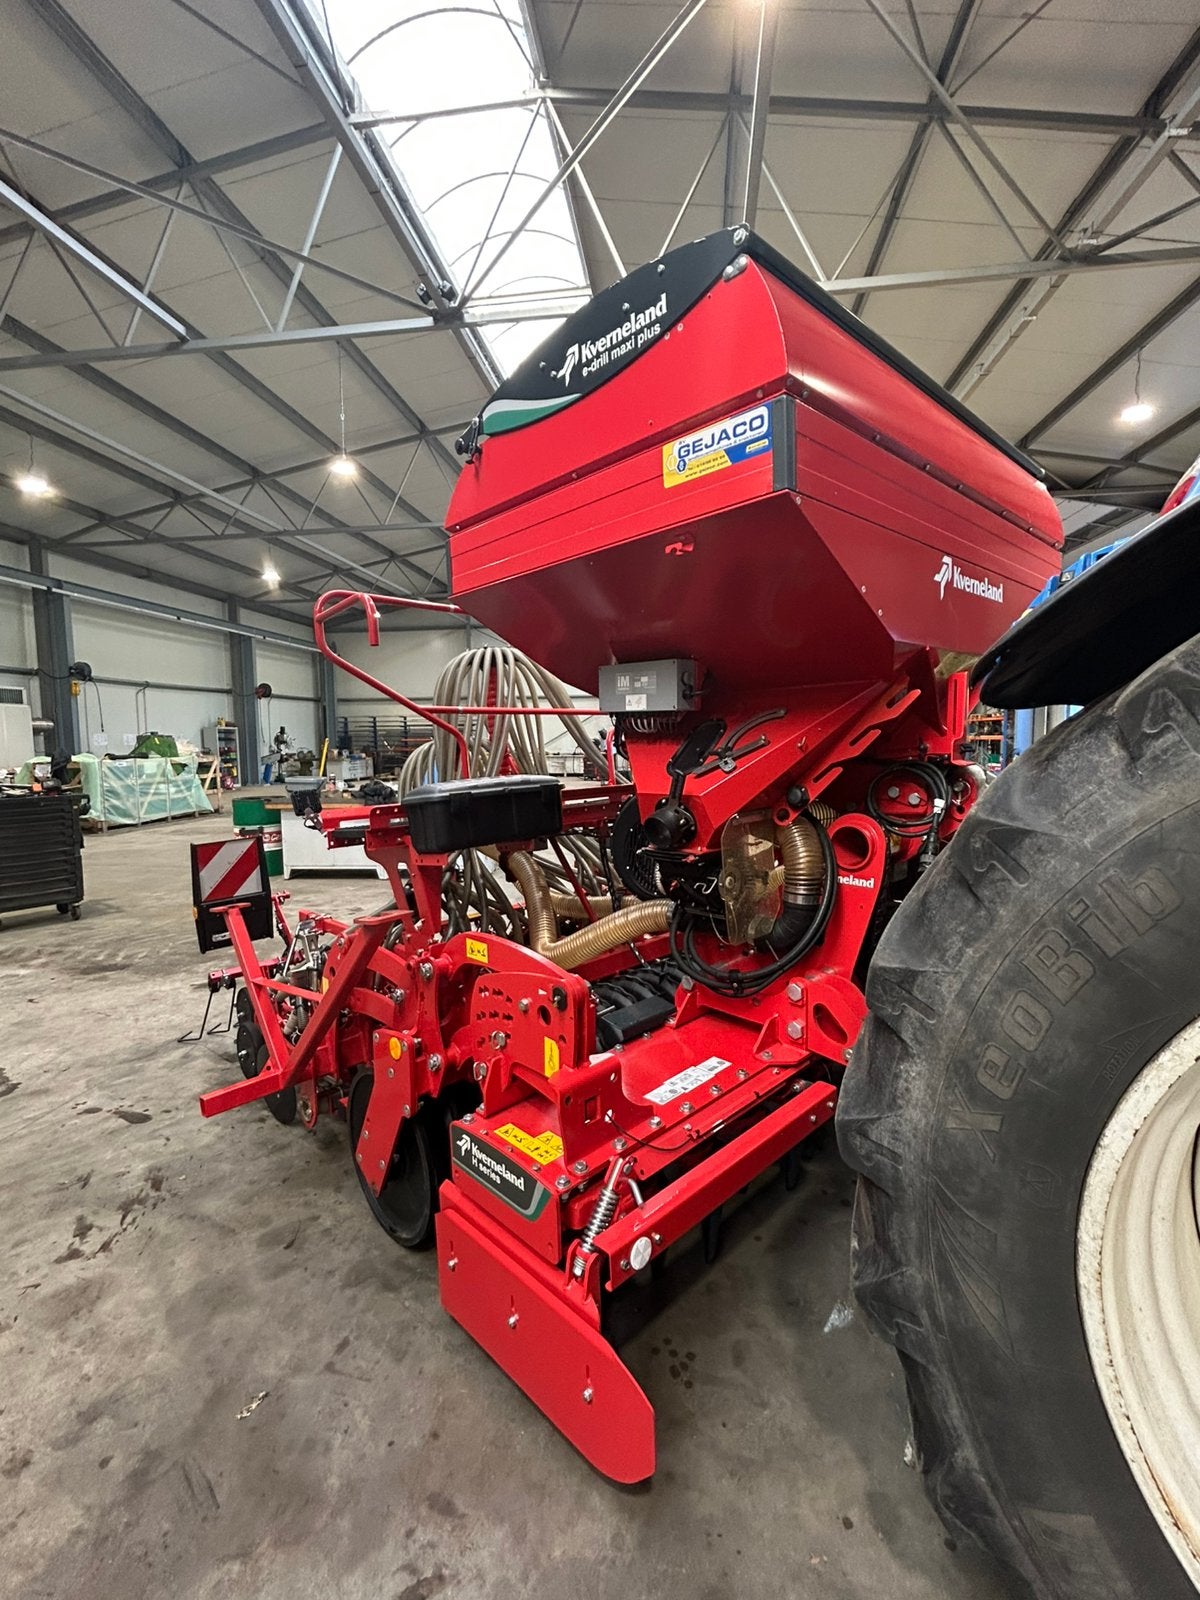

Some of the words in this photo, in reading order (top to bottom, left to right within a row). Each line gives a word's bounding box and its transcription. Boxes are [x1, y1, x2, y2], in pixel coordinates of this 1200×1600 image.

[581, 293, 667, 363] Kverneland
[582, 355, 609, 377] e-drill
[611, 340, 635, 360] maxi
[637, 323, 661, 348] plus
[678, 414, 765, 459] GEJACO
[953, 565, 1003, 603] Kverneland
[837, 875, 875, 888] neland
[471, 1142, 525, 1192] Kverneland
[472, 1156, 478, 1168] H
[479, 1162, 501, 1184] series
